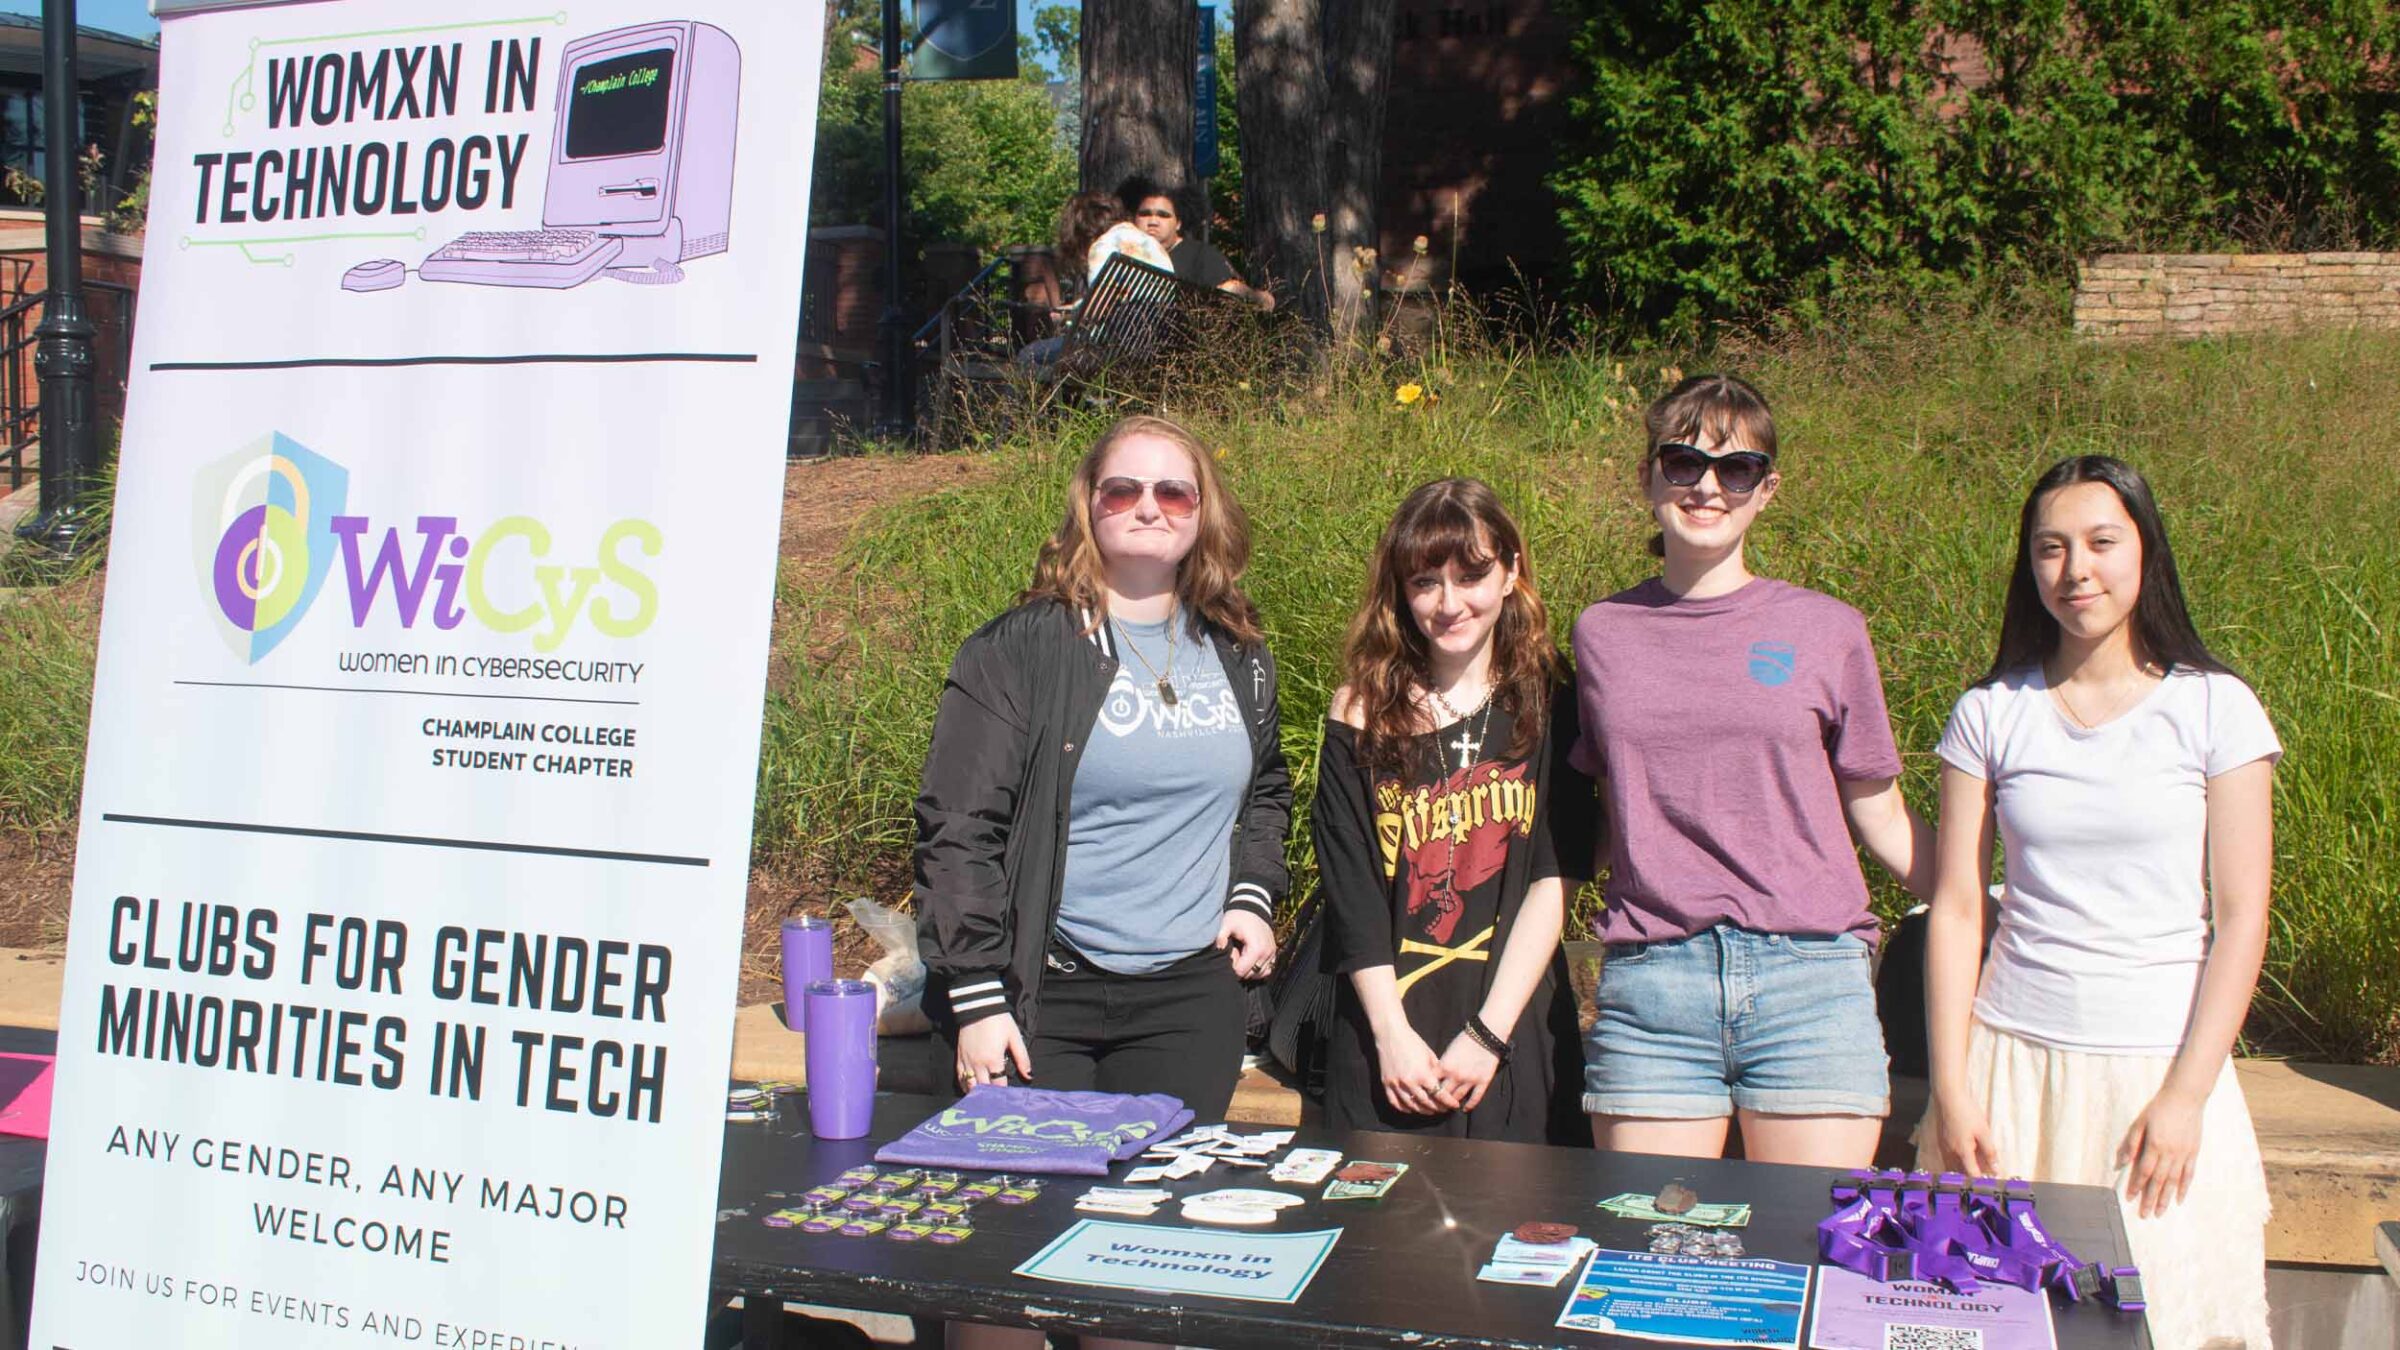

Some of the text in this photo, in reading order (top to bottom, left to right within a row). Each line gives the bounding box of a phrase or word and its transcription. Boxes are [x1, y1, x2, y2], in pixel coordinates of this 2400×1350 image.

[269, 37, 542, 129] WOMXN IN
[628, 66, 659, 87] College
[194, 134, 529, 223] TECHNOLOGY
[330, 515, 664, 653] WiCyS
[422, 717, 637, 747] CHAMPLAIN COLLEGE
[1157, 727, 1217, 739] NASHVILLE
[432, 748, 633, 778] STUDENT CHAPTER
[109, 895, 672, 1023] CLUBS FOR GENDER
[97, 984, 667, 1123] MINORITIES IN TECH
[106, 1125, 628, 1229] ANY GENDER, ANY MAJOR
[254, 1202, 450, 1263] WELCOME
[1085, 1253, 1273, 1280] Technology
[1110, 1242, 1273, 1265] Womxn in
[1658, 1255, 1699, 1265] CLUB
[1704, 1258, 1776, 1270] MEETING
[76, 1260, 578, 1350] JOIN US FOR EVENTS AND EXPERI
[1863, 1295, 2004, 1313] TECHNOLOGY
[1892, 1284, 1975, 1297] WOM
